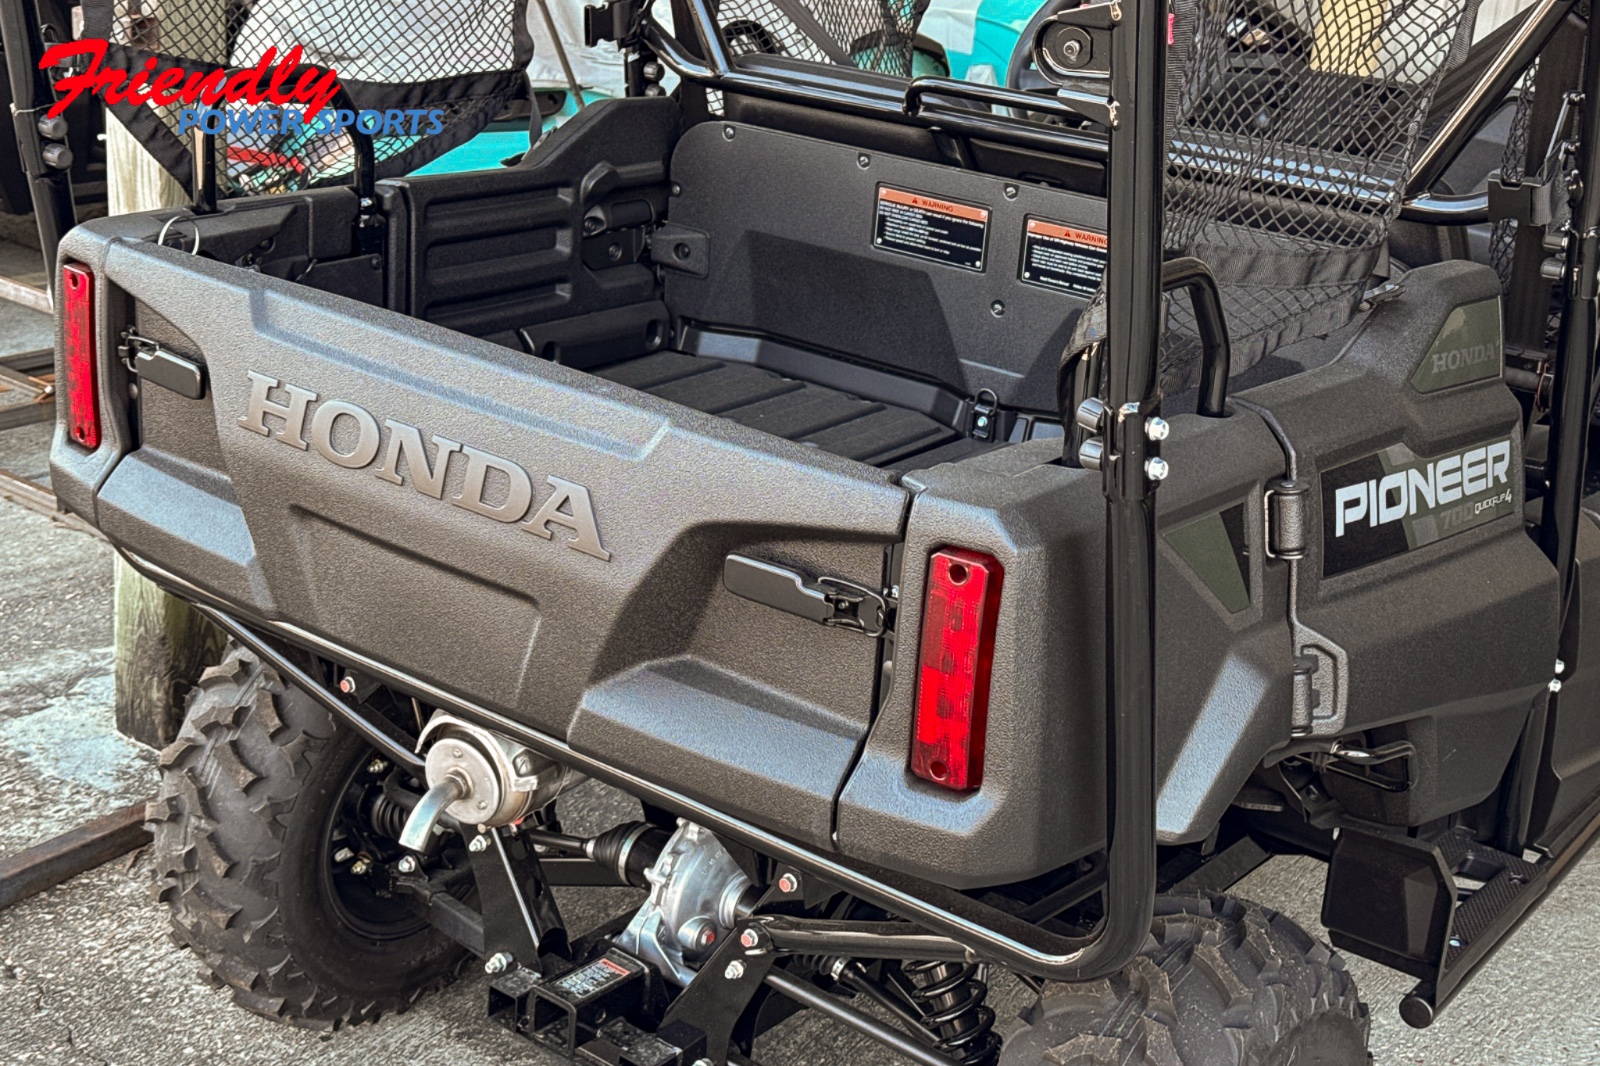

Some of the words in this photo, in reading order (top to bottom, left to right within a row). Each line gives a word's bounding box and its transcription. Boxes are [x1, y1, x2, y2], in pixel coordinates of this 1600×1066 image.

[921, 198, 954, 213] WARNING
[1431, 343, 1496, 374] HONDA
[237, 370, 611, 561] HONDA
[1335, 439, 1511, 538] PIONEER
[1440, 501, 1474, 530] 700
